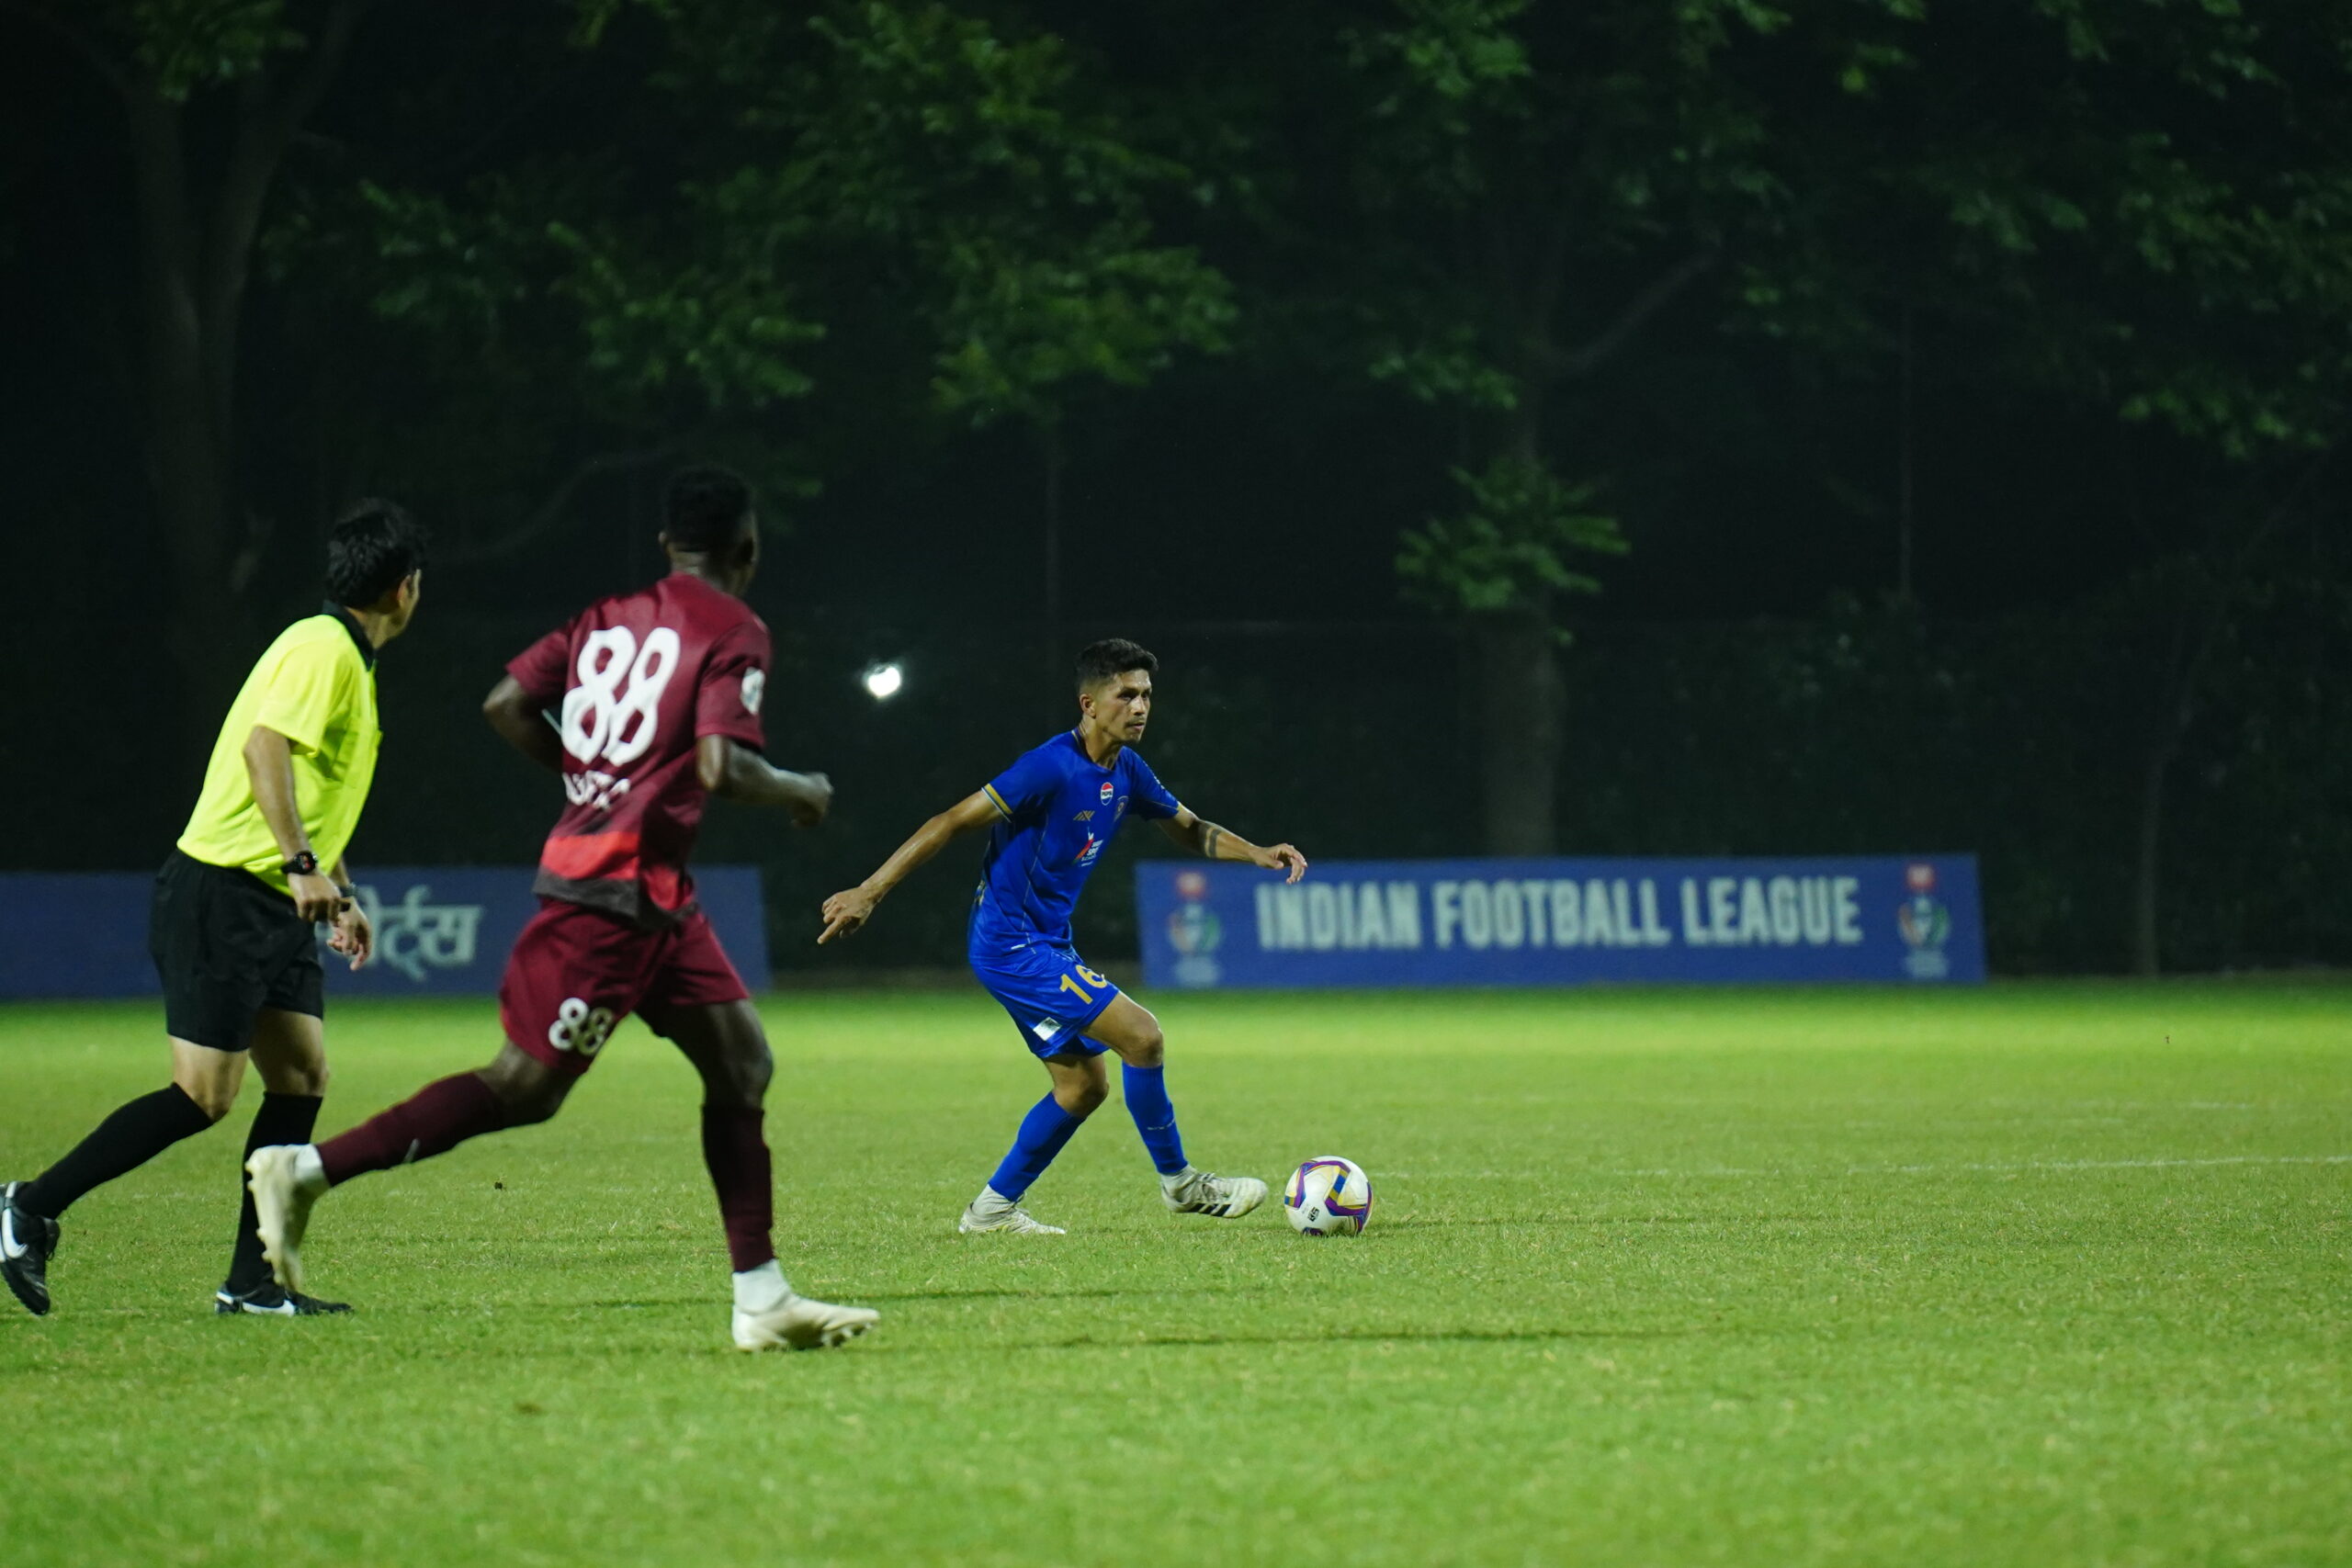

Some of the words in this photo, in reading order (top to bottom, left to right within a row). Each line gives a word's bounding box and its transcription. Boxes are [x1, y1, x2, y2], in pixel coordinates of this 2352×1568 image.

[561, 626, 681, 766] 88
[1255, 881, 1420, 949] INDIAN
[1431, 879, 1672, 949] FOOTBALL
[1680, 876, 1863, 945] LEAGUE
[1059, 964, 1108, 1005] 16
[548, 997, 615, 1055] 88
